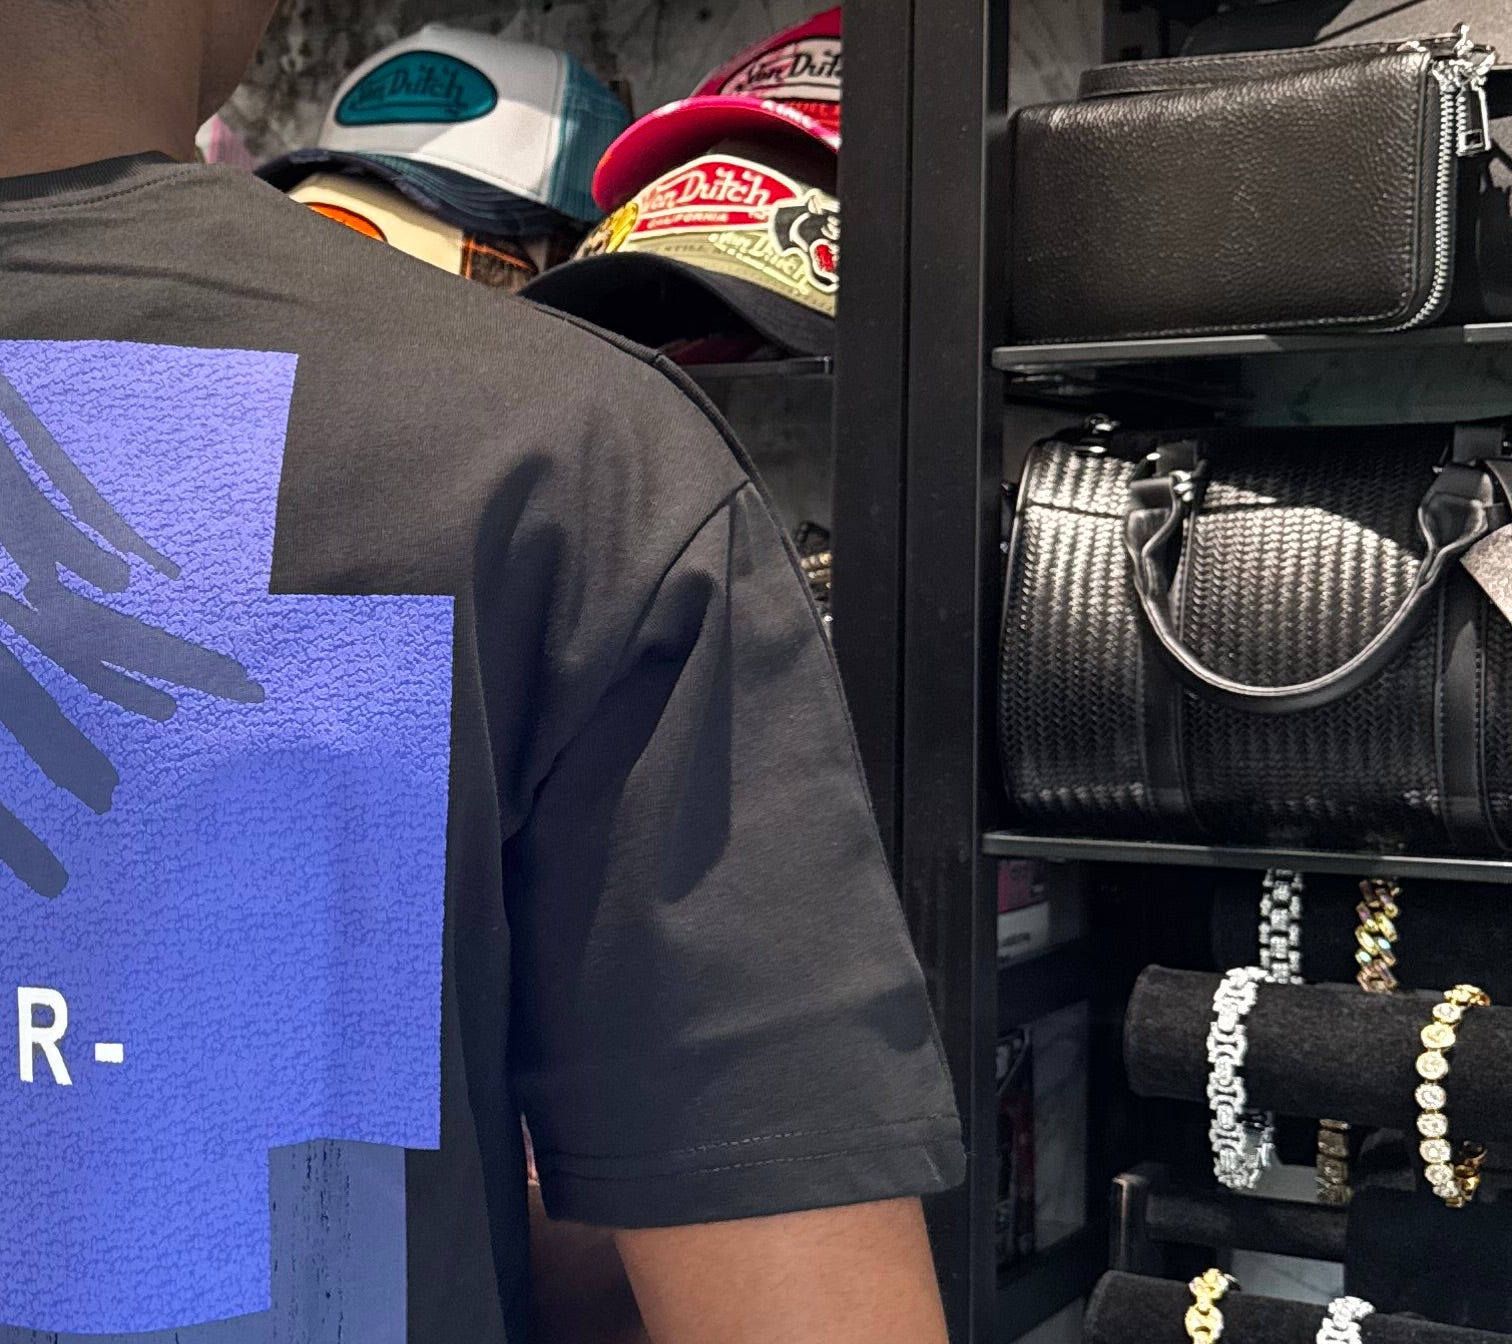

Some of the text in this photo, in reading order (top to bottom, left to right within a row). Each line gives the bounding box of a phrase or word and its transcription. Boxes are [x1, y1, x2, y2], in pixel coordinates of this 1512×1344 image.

[788, 50, 841, 78] Dut
[389, 64, 468, 108] Dutch
[641, 167, 772, 212] Von Dutch
[647, 213, 730, 230] CALIFORNIA
